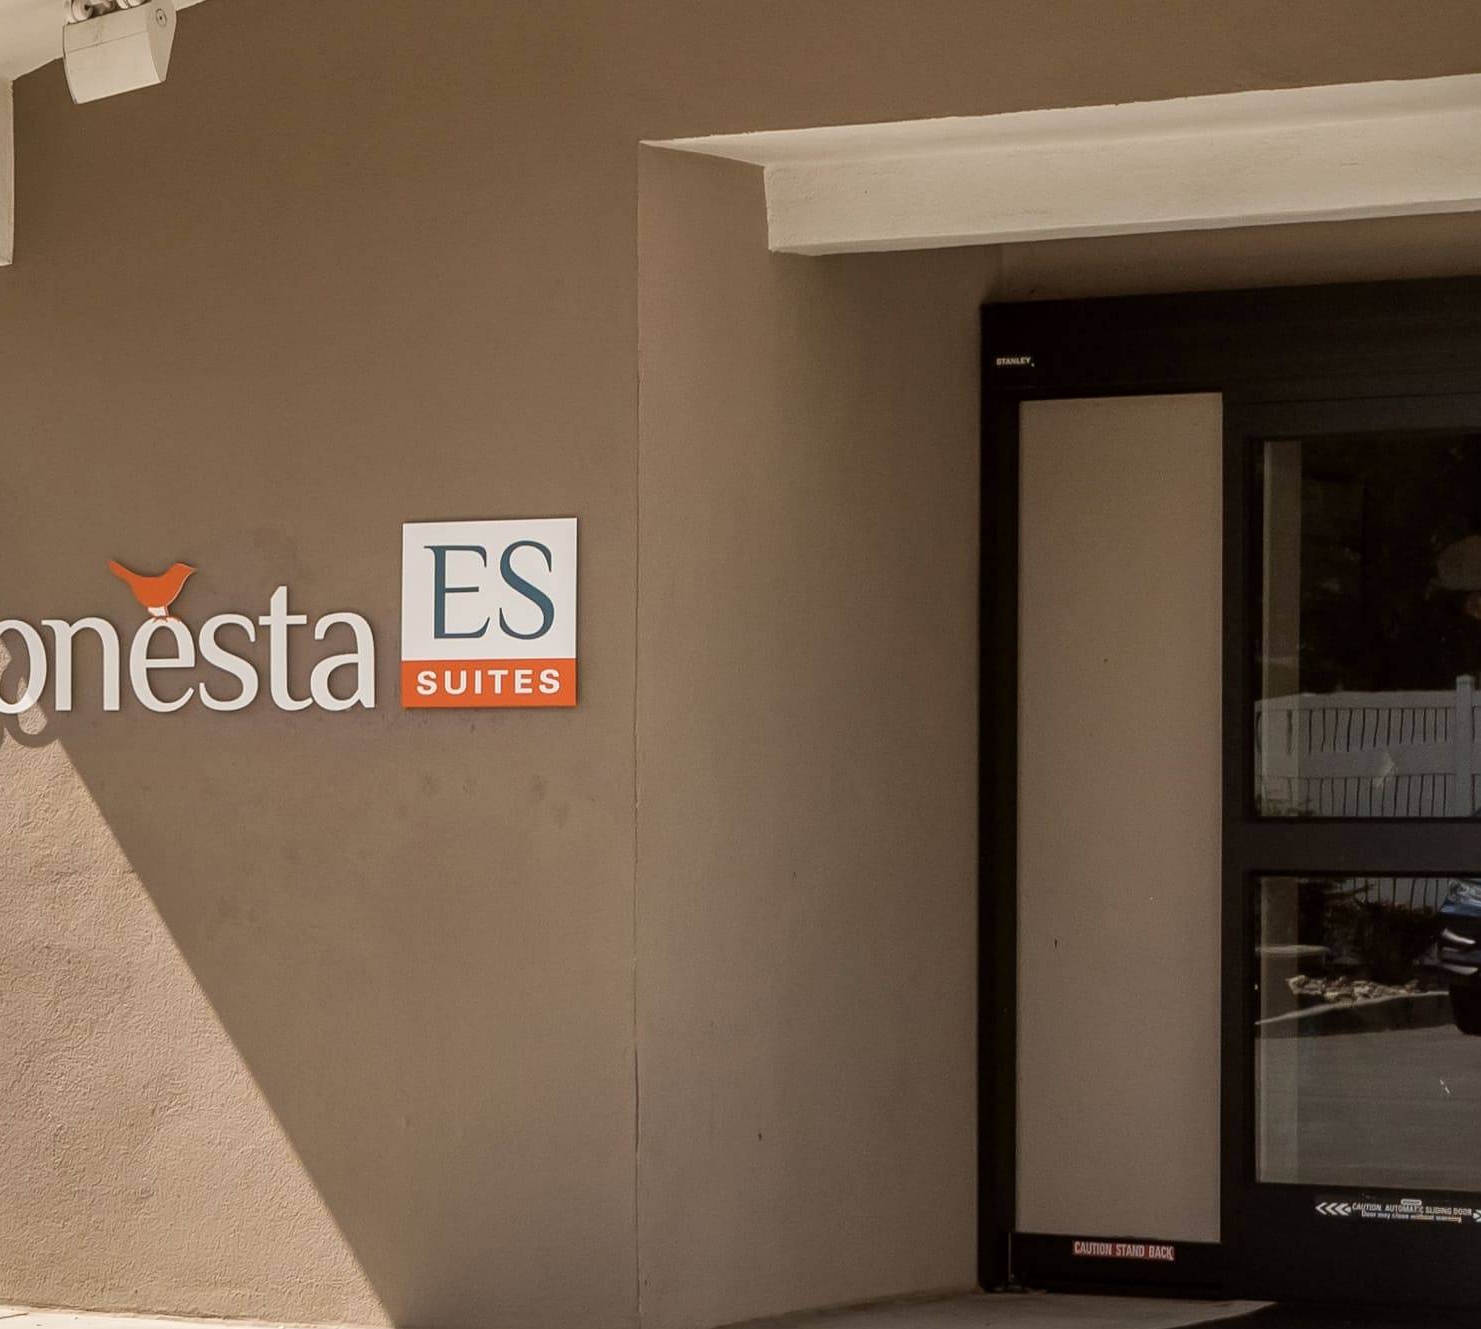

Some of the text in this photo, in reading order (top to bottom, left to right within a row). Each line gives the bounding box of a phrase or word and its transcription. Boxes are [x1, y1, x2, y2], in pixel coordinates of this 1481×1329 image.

[996, 356, 1031, 366] STANLEY
[423, 539, 556, 641] ES
[415, 668, 561, 696] SUITES
[1074, 1241, 1175, 1261] CAUTION STAND BACK
